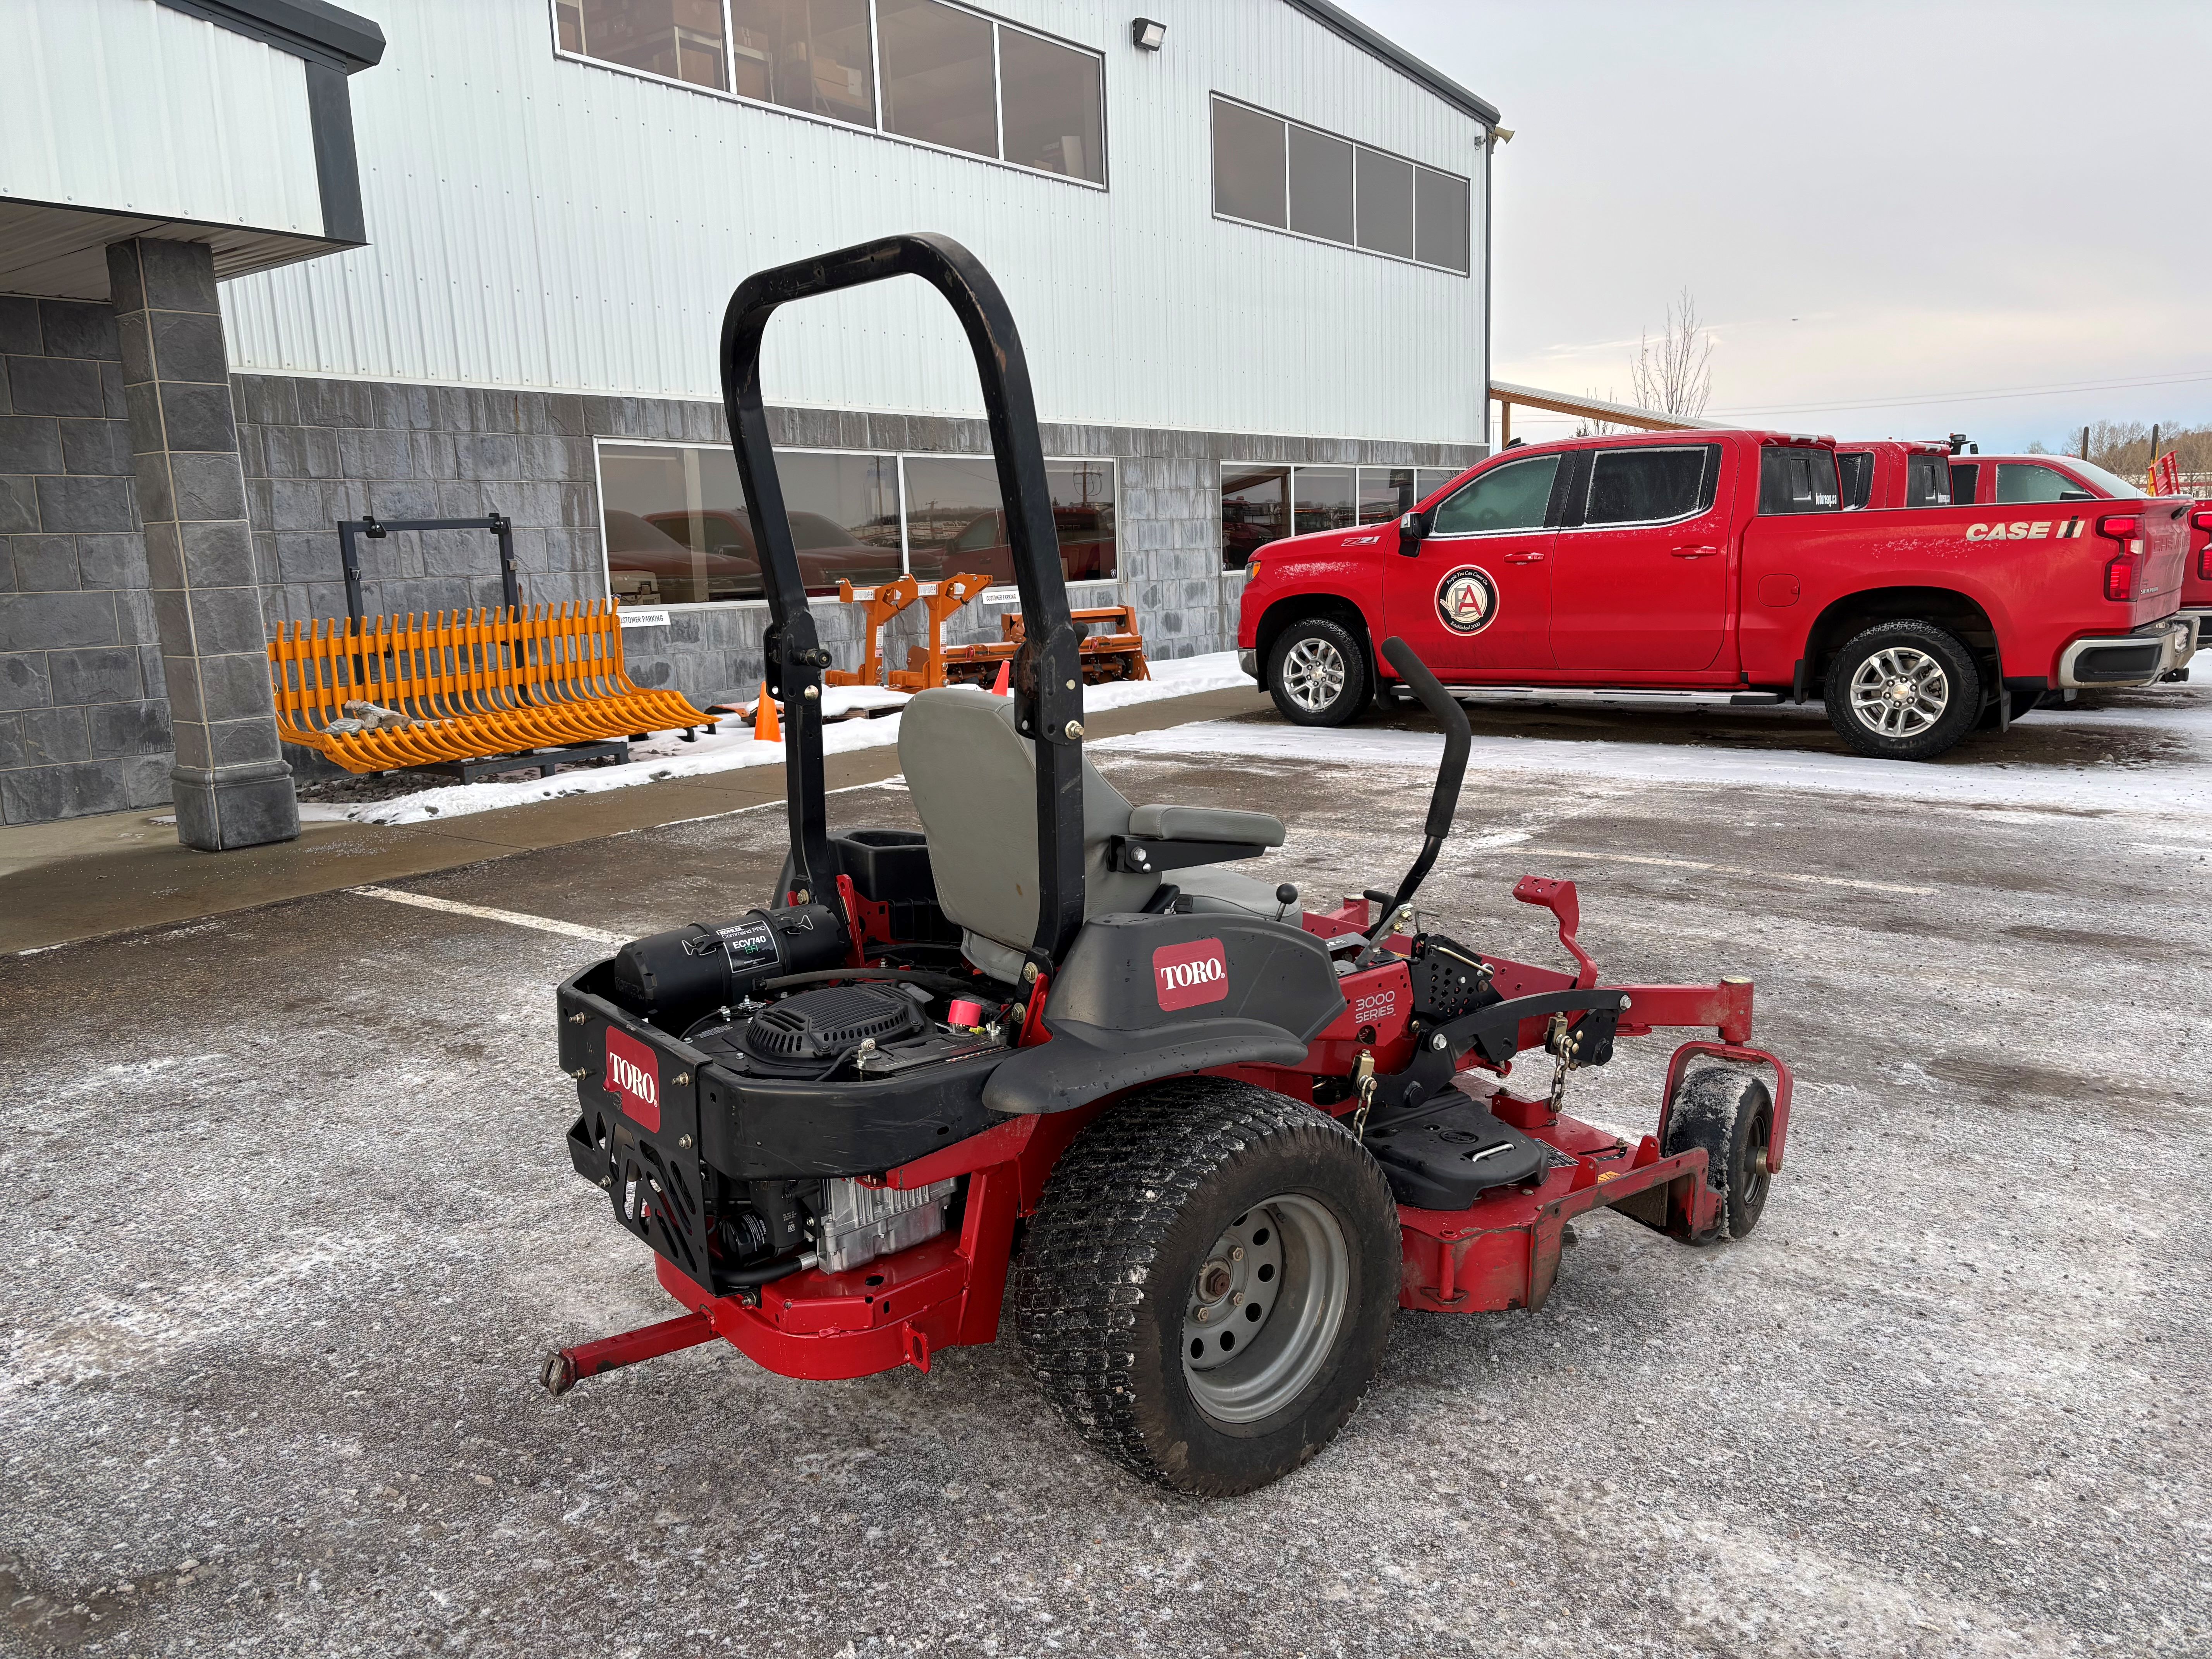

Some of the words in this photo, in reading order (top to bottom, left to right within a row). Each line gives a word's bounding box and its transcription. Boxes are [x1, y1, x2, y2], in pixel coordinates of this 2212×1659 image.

[1966, 522, 2052, 541] CASE
[1473, 572, 1484, 580] Count
[722, 929, 752, 939] Command
[732, 936, 766, 949] ECV740
[745, 945, 759, 954] EFI
[1161, 958, 1221, 990] TORO
[1355, 991, 1395, 1011] 3000
[1355, 1004, 1394, 1024] SERIES
[610, 1052, 655, 1104] TORO
